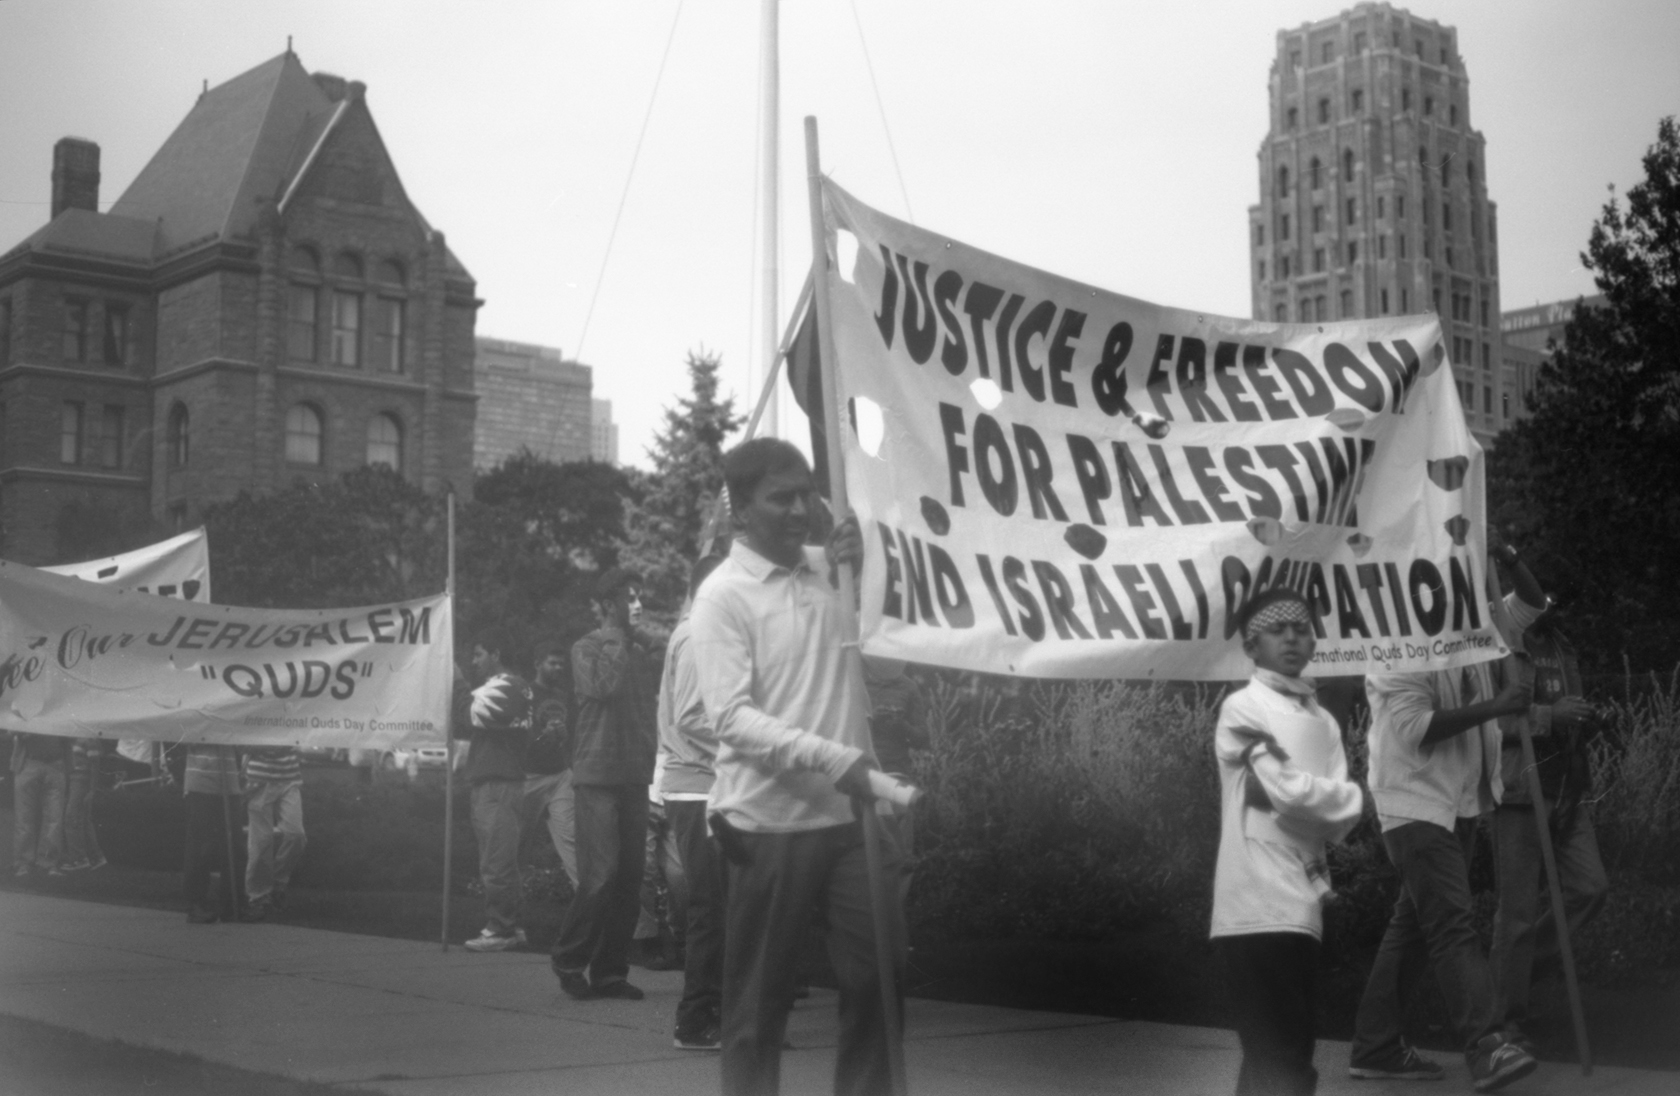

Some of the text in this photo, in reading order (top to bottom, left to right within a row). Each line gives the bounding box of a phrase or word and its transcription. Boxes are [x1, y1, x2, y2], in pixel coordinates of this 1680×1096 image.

[874, 243, 1420, 422] JUSTICE & FREEDOM
[939, 401, 1071, 523] FOR
[877, 520, 976, 629] END
[974, 553, 1209, 642] ISRAELI
[57, 624, 138, 670] Our
[146, 606, 432, 650] JERUSALEM
[1371, 643, 1404, 664] Quds
[1405, 643, 1430, 662] Day
[1433, 635, 1493, 656] Committee
[200, 659, 374, 700] "QUDS"
[243, 714, 434, 733] International Quds Day Committee
